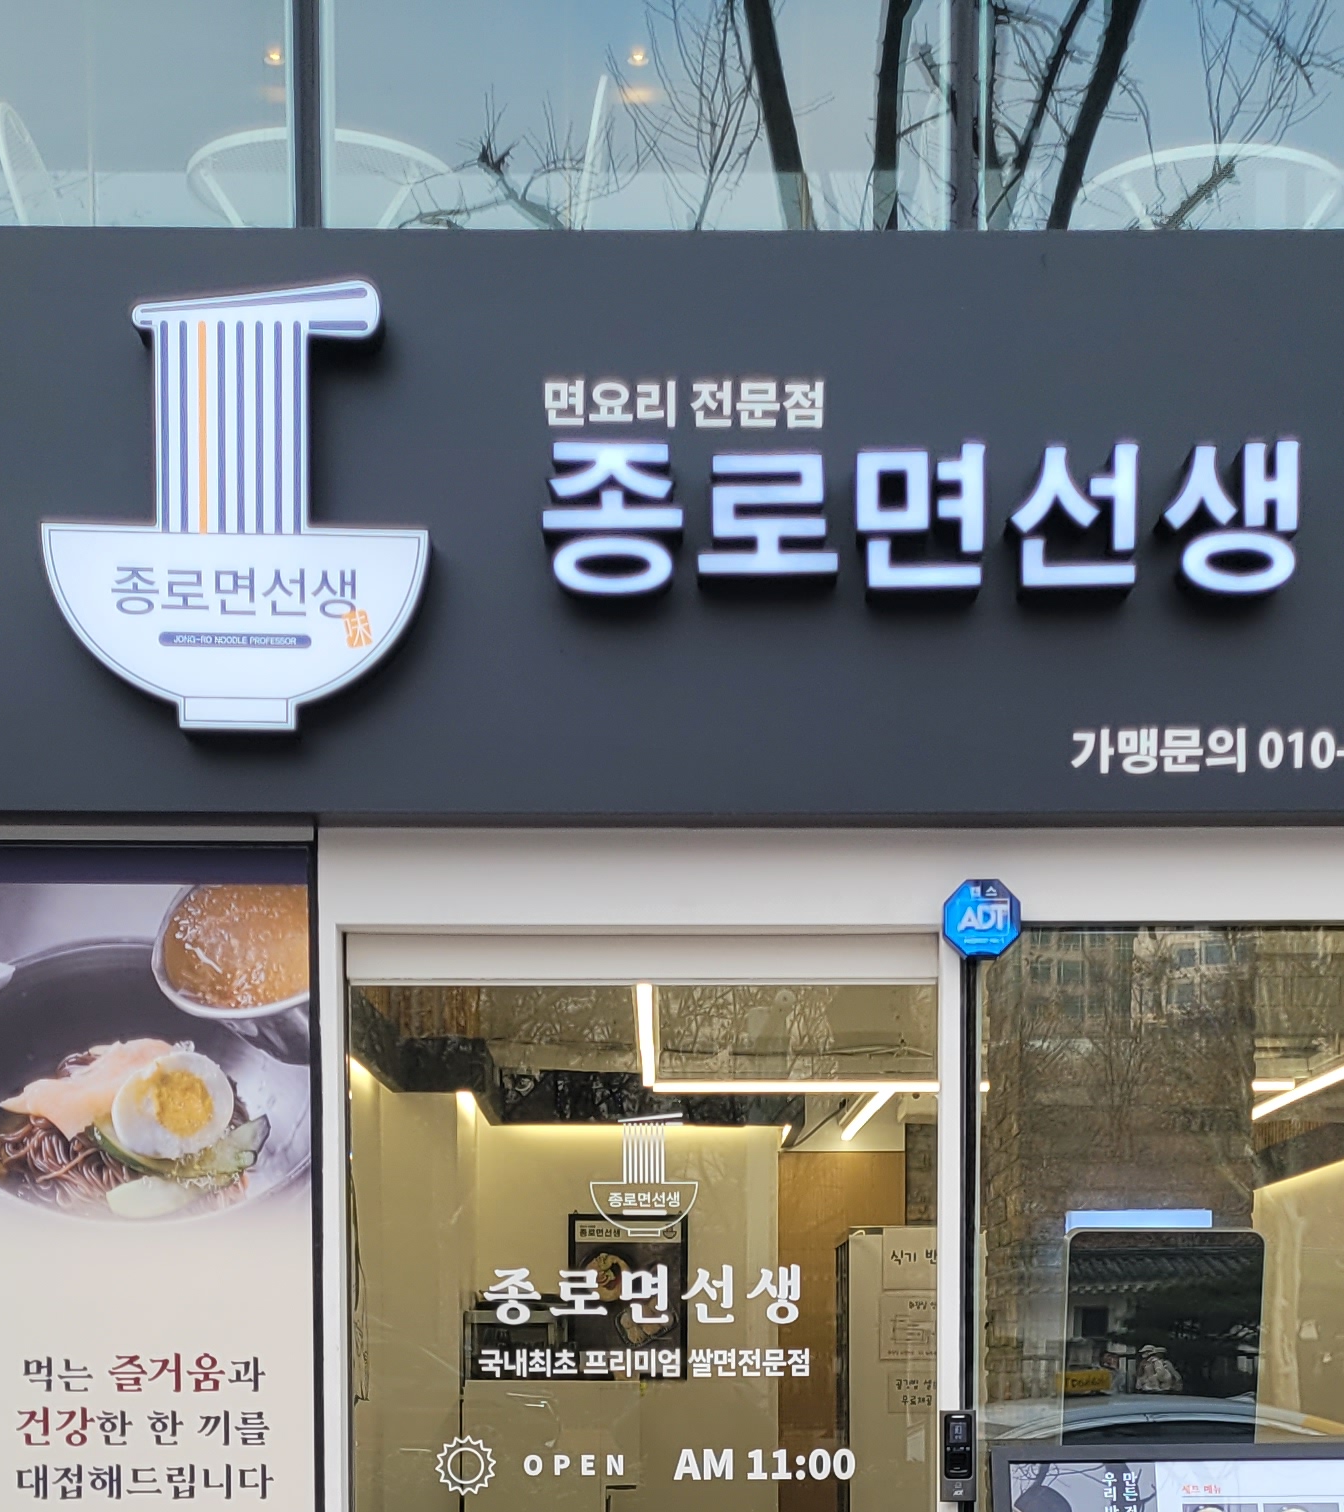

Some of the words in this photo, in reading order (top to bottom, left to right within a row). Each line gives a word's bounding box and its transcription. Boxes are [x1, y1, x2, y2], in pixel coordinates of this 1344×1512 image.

[543, 379, 677, 427] 면요리
[690, 380, 824, 428] 전문점
[541, 440, 1299, 595] 종로면선생
[111, 565, 358, 618] 종로면선생
[173, 634, 212, 645] JONG-RO
[214, 635, 247, 645] NOODLE
[249, 635, 298, 646] PROFESSOR
[1070, 727, 1247, 775] 가맹문의
[957, 902, 1009, 933] ADT
[607, 1188, 681, 1209] 종로면선생
[483, 1263, 802, 1326] 종로면선생
[23, 1356, 93, 1392] 먹는
[108, 1353, 266, 1392] 즐거움과
[478, 1348, 578, 1378] 국내최초
[584, 1348, 681, 1378] 프리미엄
[687, 1347, 811, 1378] 쌀면전문점
[16, 1406, 133, 1447] 건강한
[147, 1410, 184, 1446] 한
[197, 1410, 270, 1446] 끼를
[16, 1464, 274, 1500] 대접해드립니다
[523, 1454, 626, 1477] OPEN
[674, 1448, 735, 1482] AM
[746, 1447, 857, 1482] 11:00
[1102, 1471, 1118, 1502] 우리
[1122, 1471, 1139, 1502] 만든
